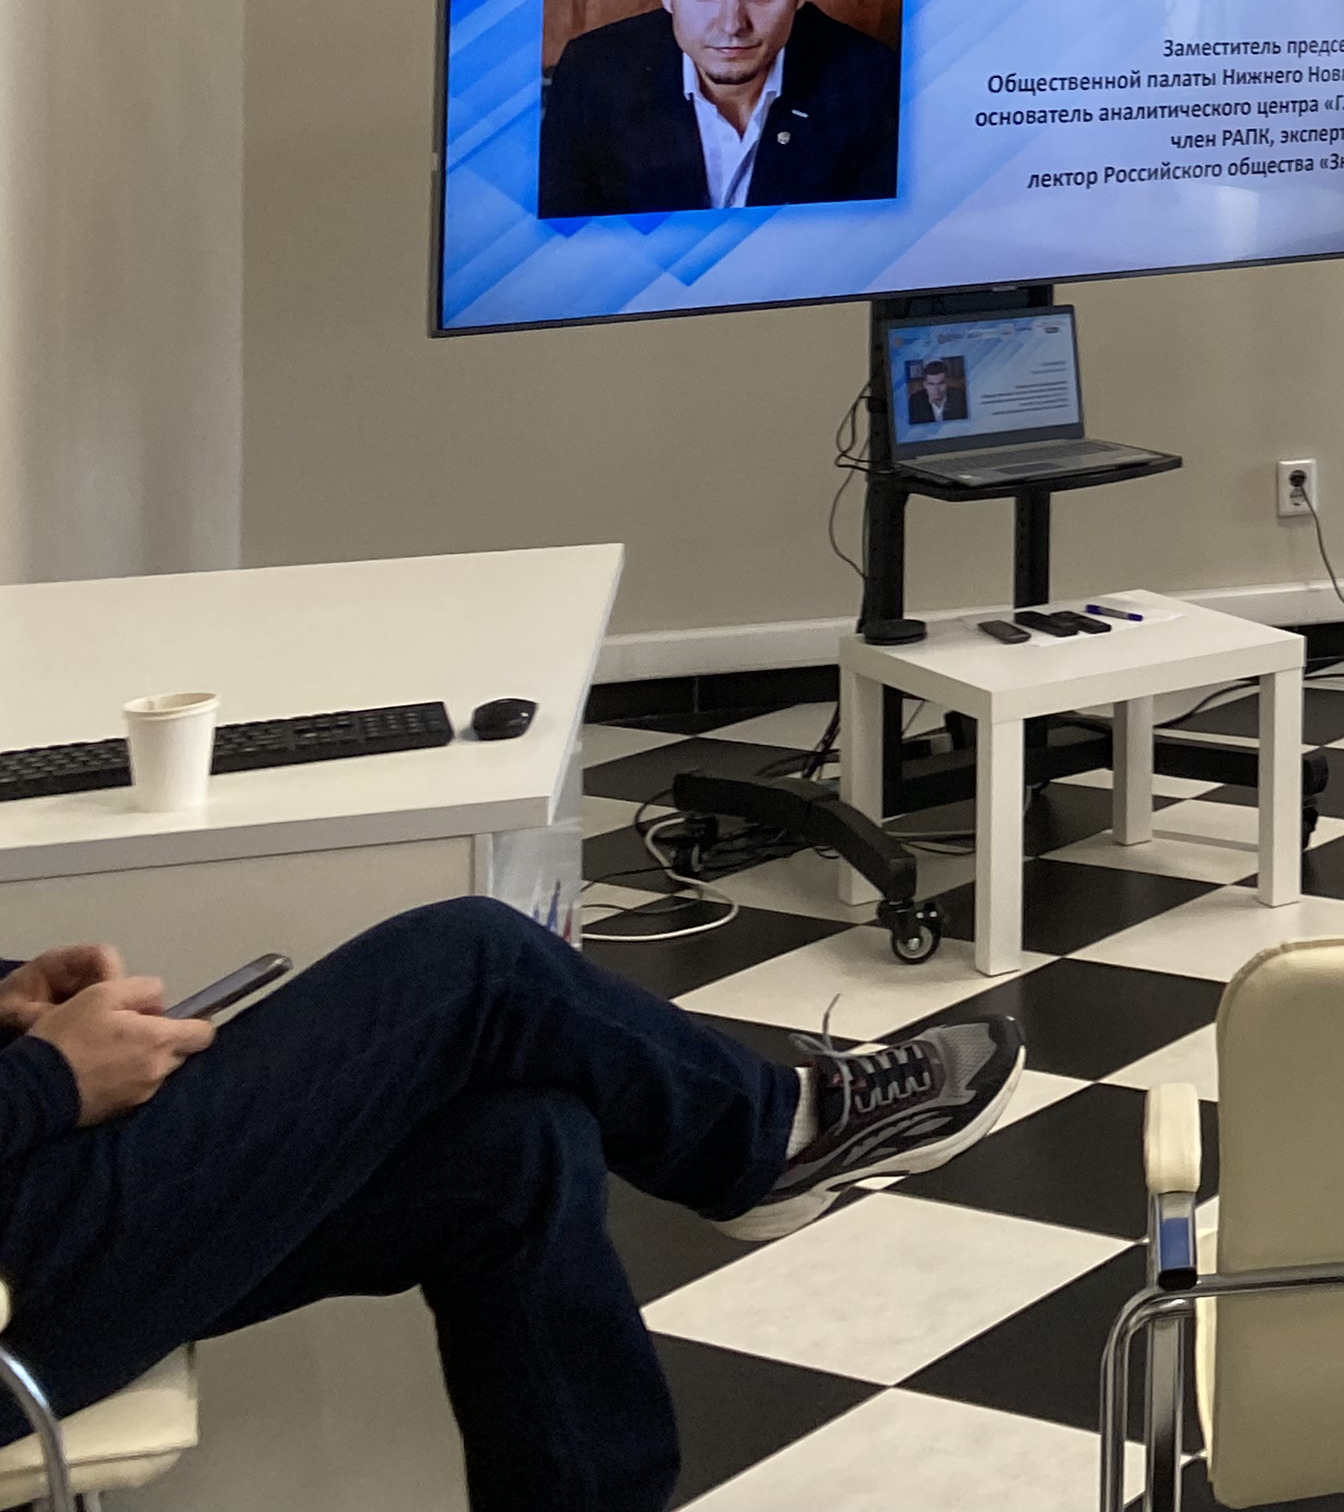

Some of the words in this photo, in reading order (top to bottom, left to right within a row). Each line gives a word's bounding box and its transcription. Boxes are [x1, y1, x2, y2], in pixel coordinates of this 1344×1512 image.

[1163, 39, 1281, 58] Заместитель
[987, 70, 1142, 96] Общественной
[1147, 70, 1217, 89] палаты
[1222, 67, 1303, 86] Нижнего
[975, 106, 1093, 128] основатель
[1098, 101, 1252, 122] аналитического
[1257, 98, 1320, 118] центра
[1170, 134, 1216, 149] член
[1222, 128, 1275, 148] РАПК,
[1027, 171, 1098, 190] лектор
[1104, 163, 1222, 186] Российского
[1227, 159, 1315, 180] общества
